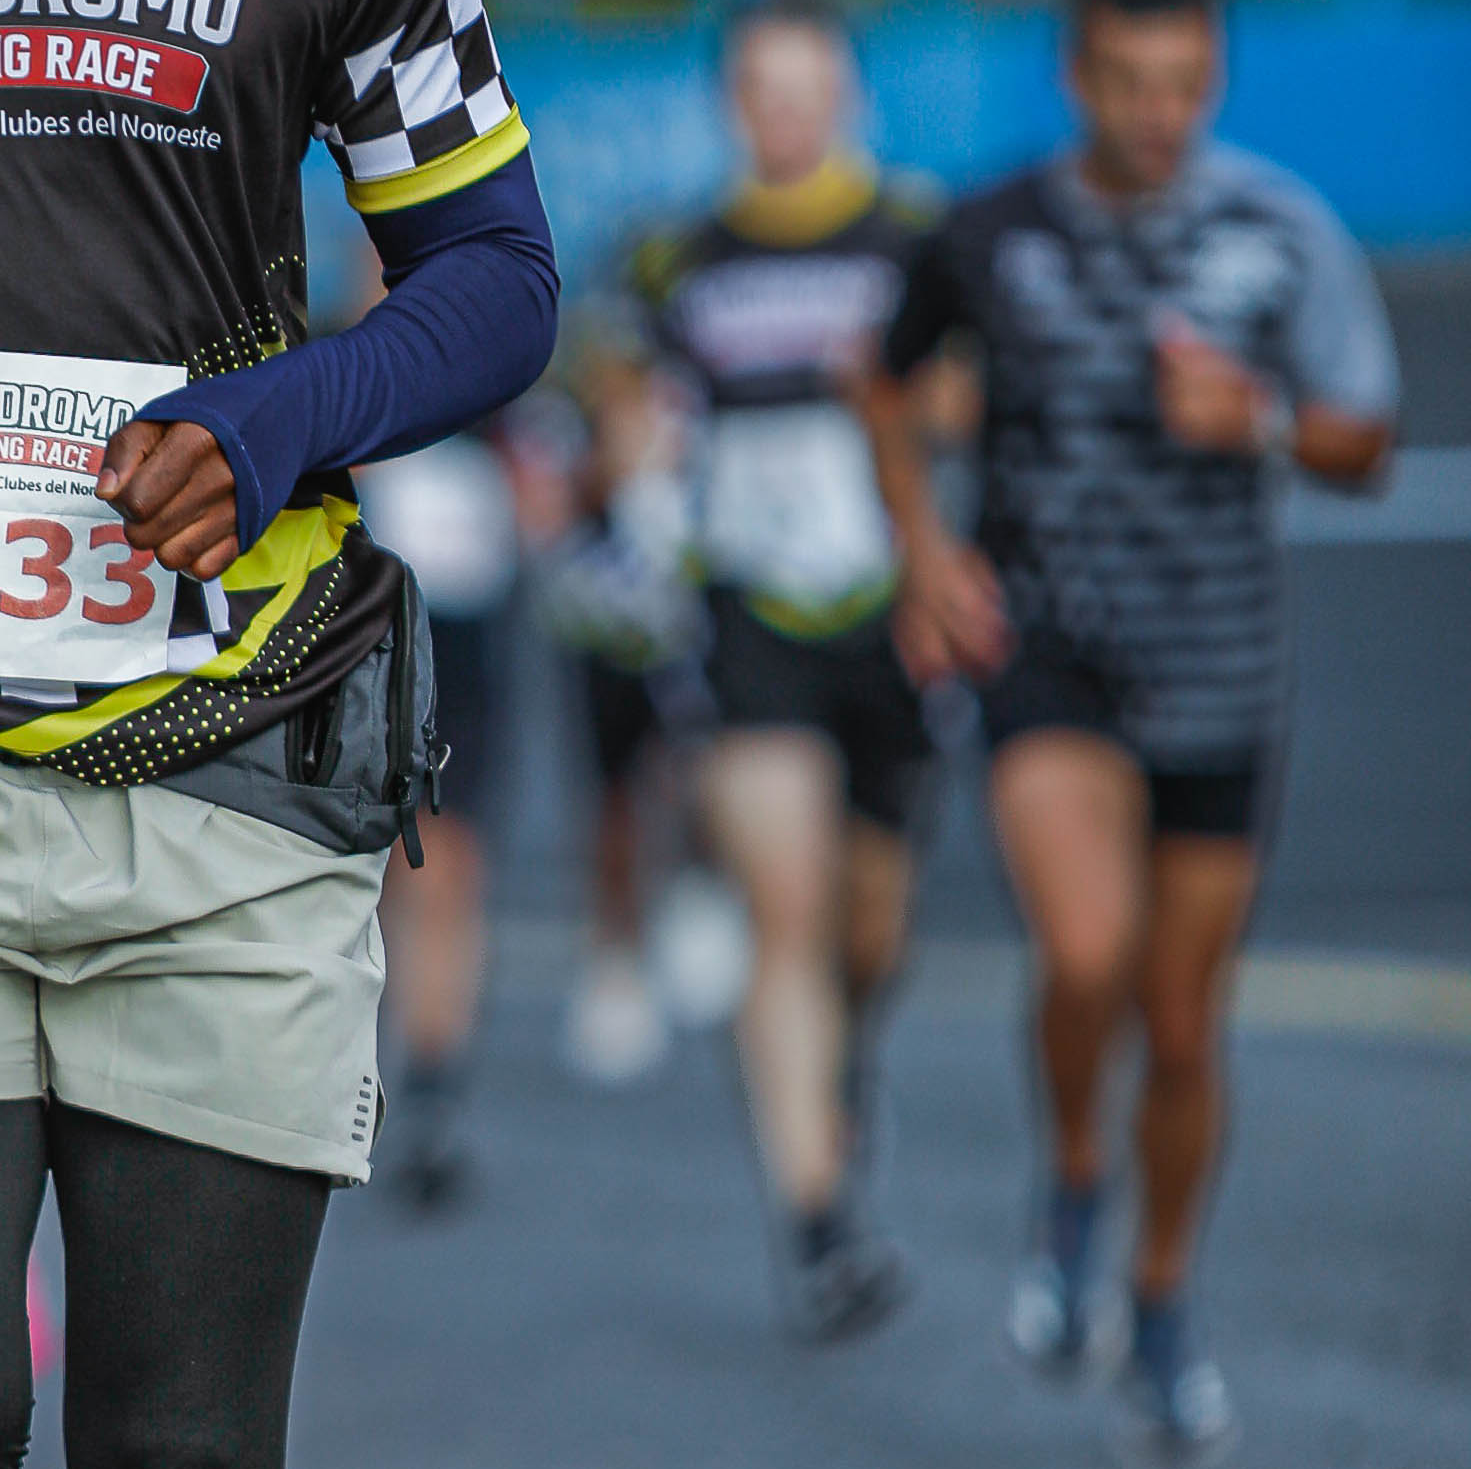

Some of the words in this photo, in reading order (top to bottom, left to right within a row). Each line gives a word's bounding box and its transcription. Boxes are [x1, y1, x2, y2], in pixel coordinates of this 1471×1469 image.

[45, 34, 162, 96] RACE
[78, 109, 117, 136] del
[121, 112, 222, 150] Noroeste
[31, 437, 93, 471] RACE
[44, 478, 67, 494] del
